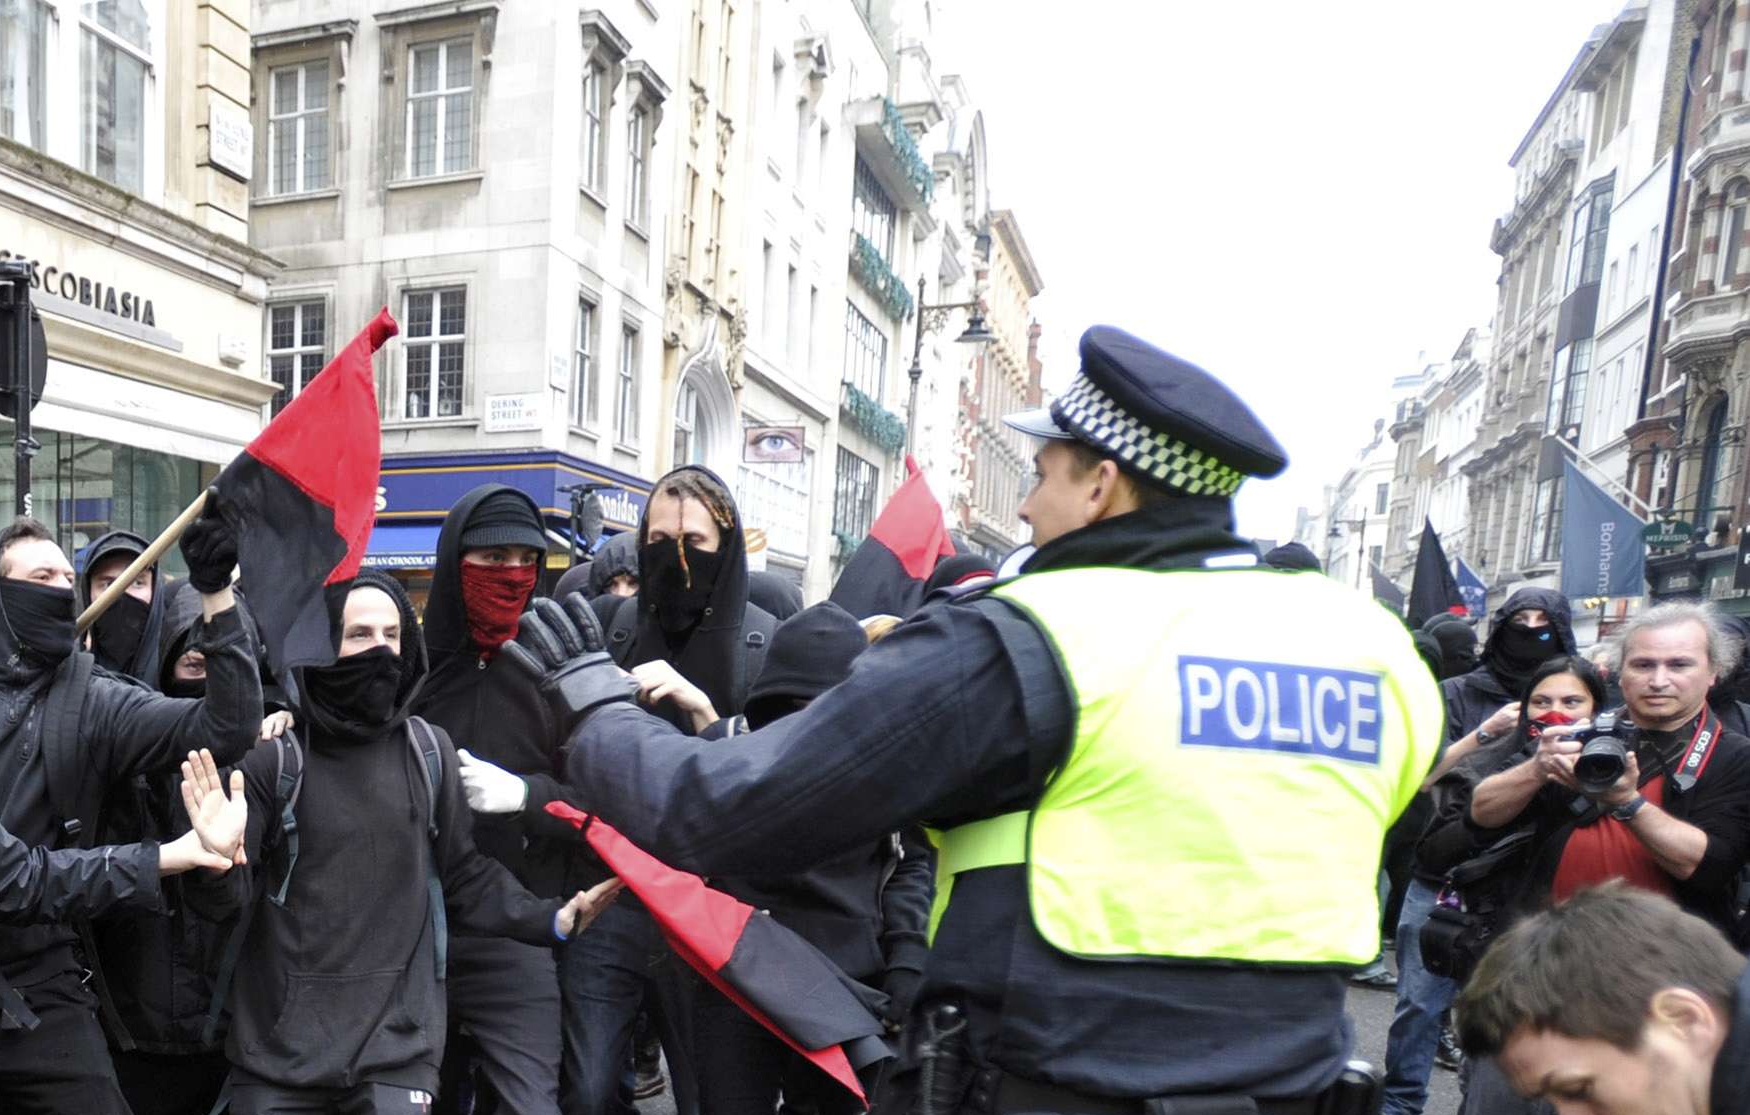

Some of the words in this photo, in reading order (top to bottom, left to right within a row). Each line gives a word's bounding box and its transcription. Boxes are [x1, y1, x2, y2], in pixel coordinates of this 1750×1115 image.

[490, 409, 522, 421] STREET
[1597, 522, 1615, 594] Bonhams
[1185, 663, 1377, 754] POLICE
[1694, 730, 1711, 752] EOS
